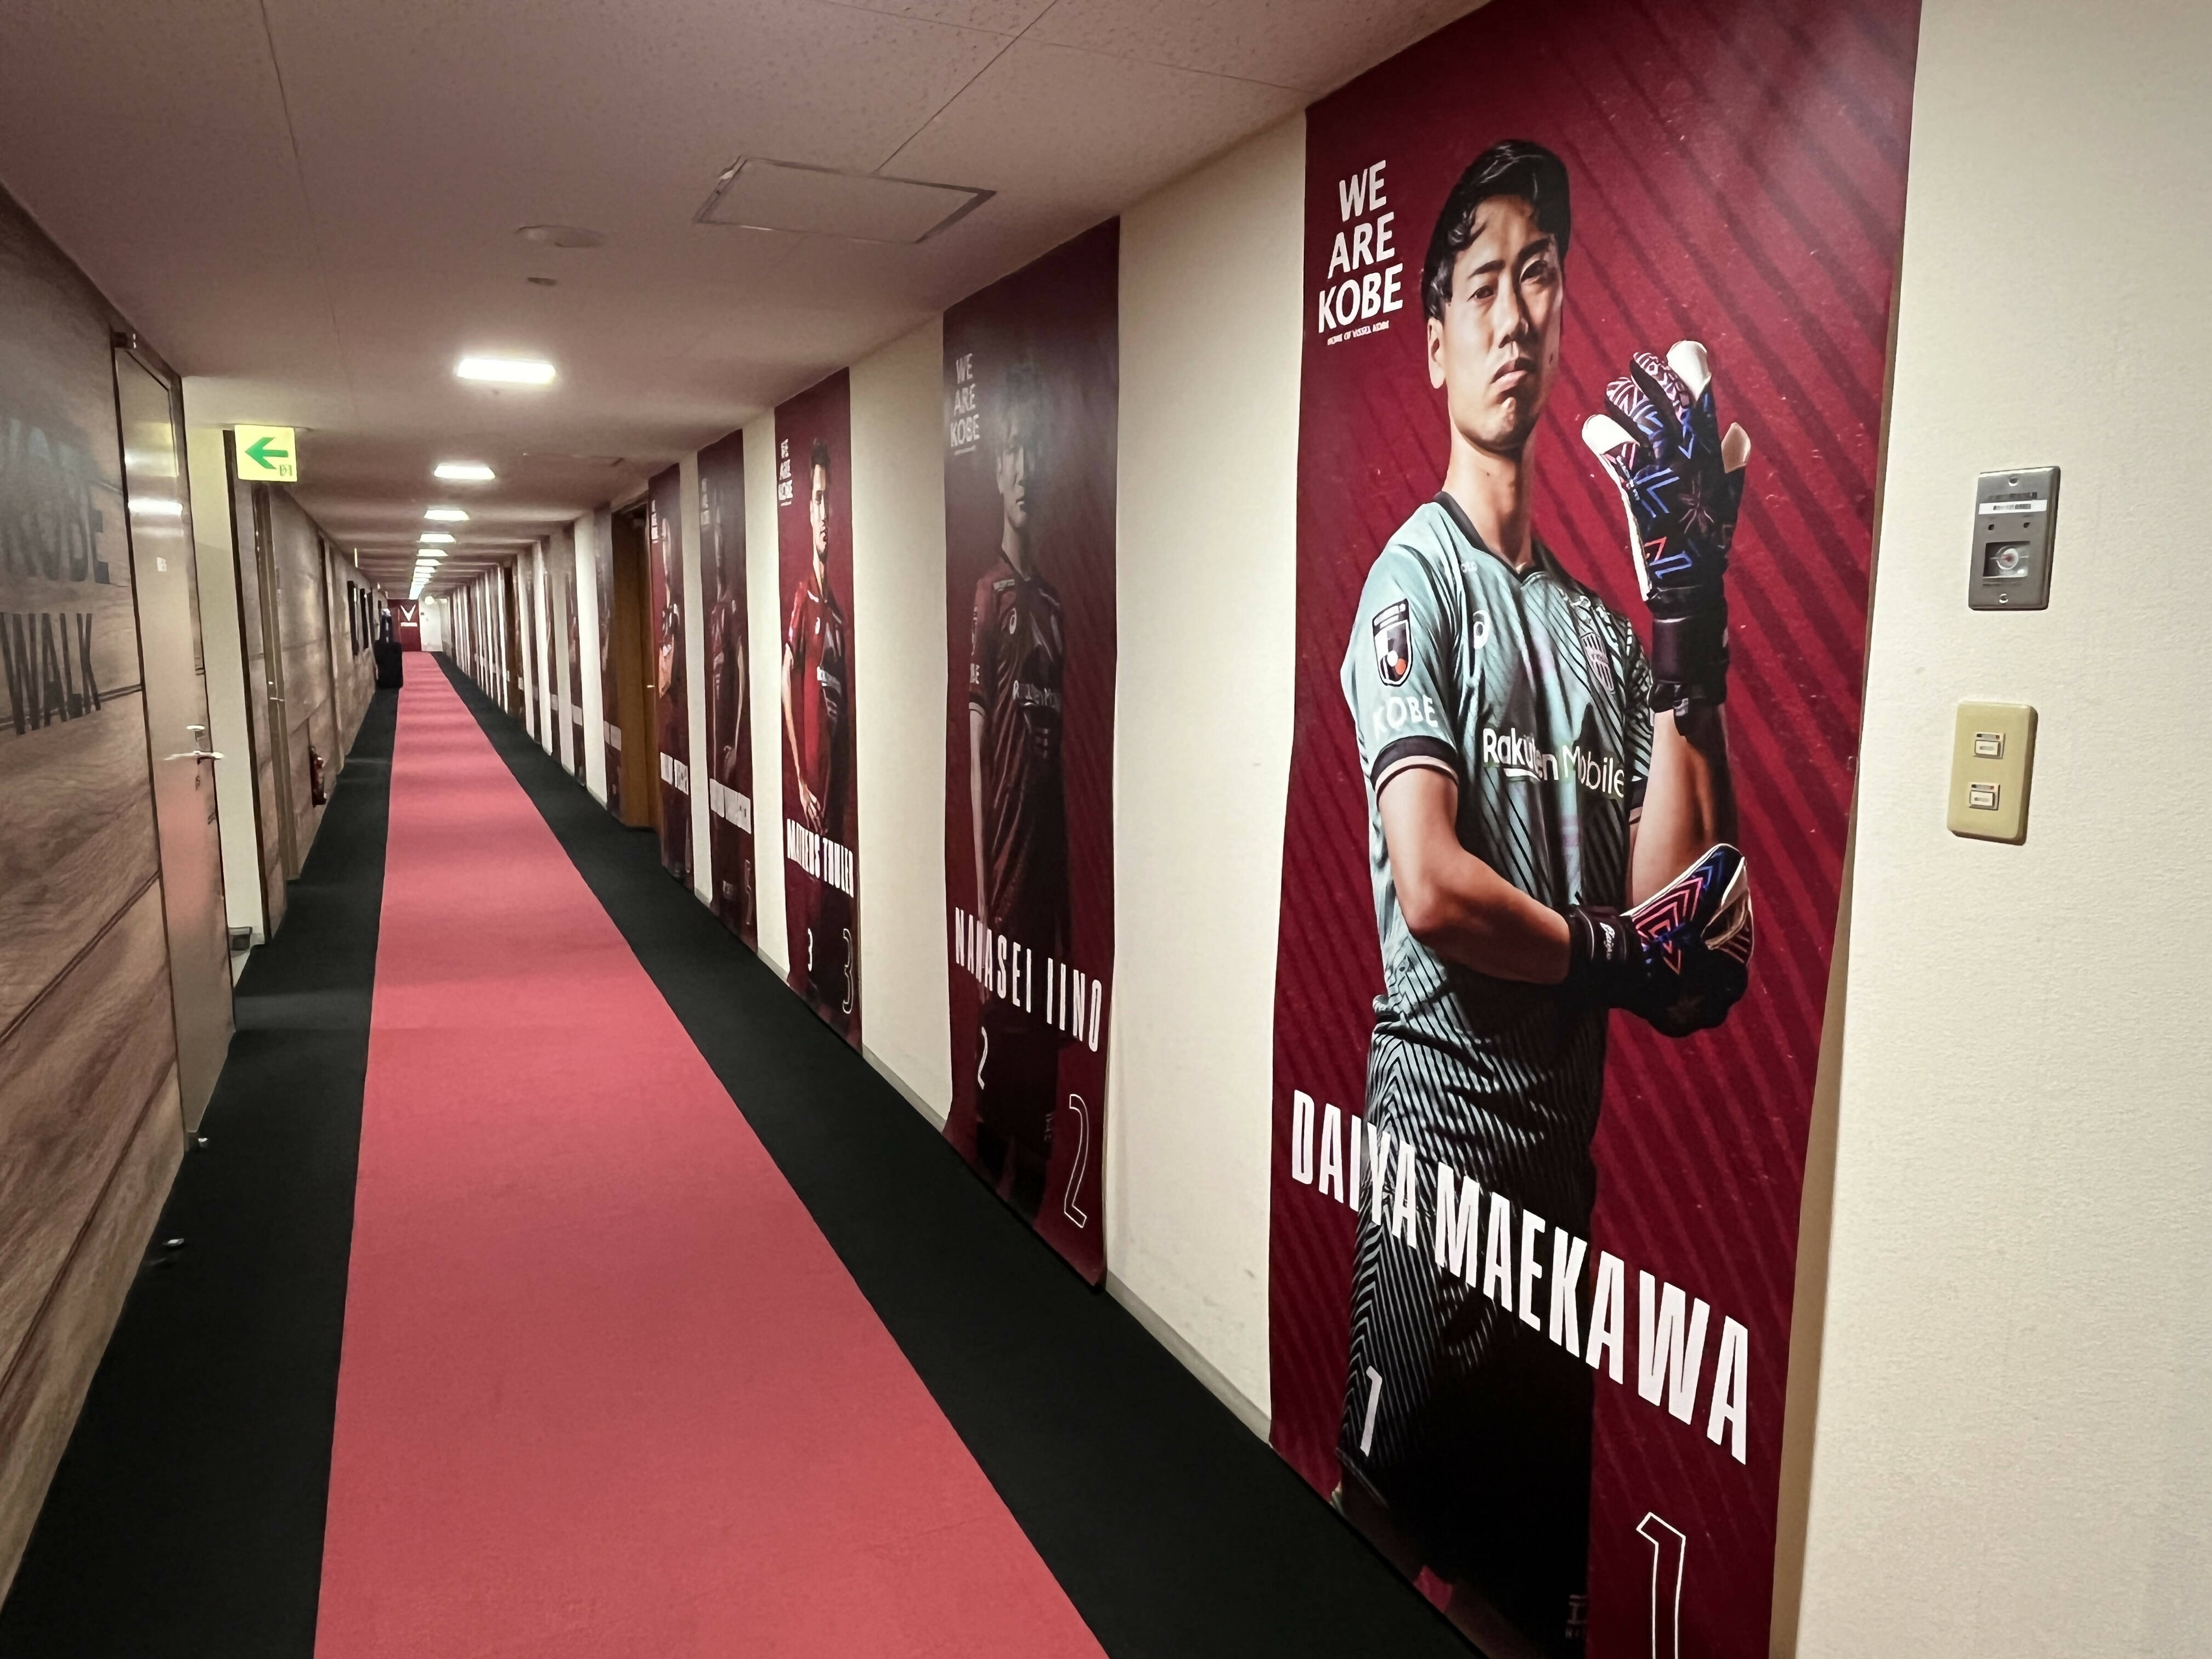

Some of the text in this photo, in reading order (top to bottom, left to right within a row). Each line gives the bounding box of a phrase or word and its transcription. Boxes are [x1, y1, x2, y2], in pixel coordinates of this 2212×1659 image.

[1339, 160, 1387, 222] WE
[1327, 212, 1395, 279] ARE
[1318, 263, 1403, 334] KOBE
[953, 383, 976, 416] ARE
[956, 353, 973, 384] WE
[950, 414, 980, 447] KOBE
[0, 612, 101, 735] WALK
[1373, 694, 1439, 742] KOBE
[1483, 727, 1559, 781] Rakuen
[842, 928, 854, 1014] 3
[955, 906, 1102, 1053] NANASEI IINO
[1064, 1093, 1090, 1229] 2
[1291, 1090, 1748, 1465] DAIYA MAEKAWA
[1636, 1511, 1686, 1659] 1
